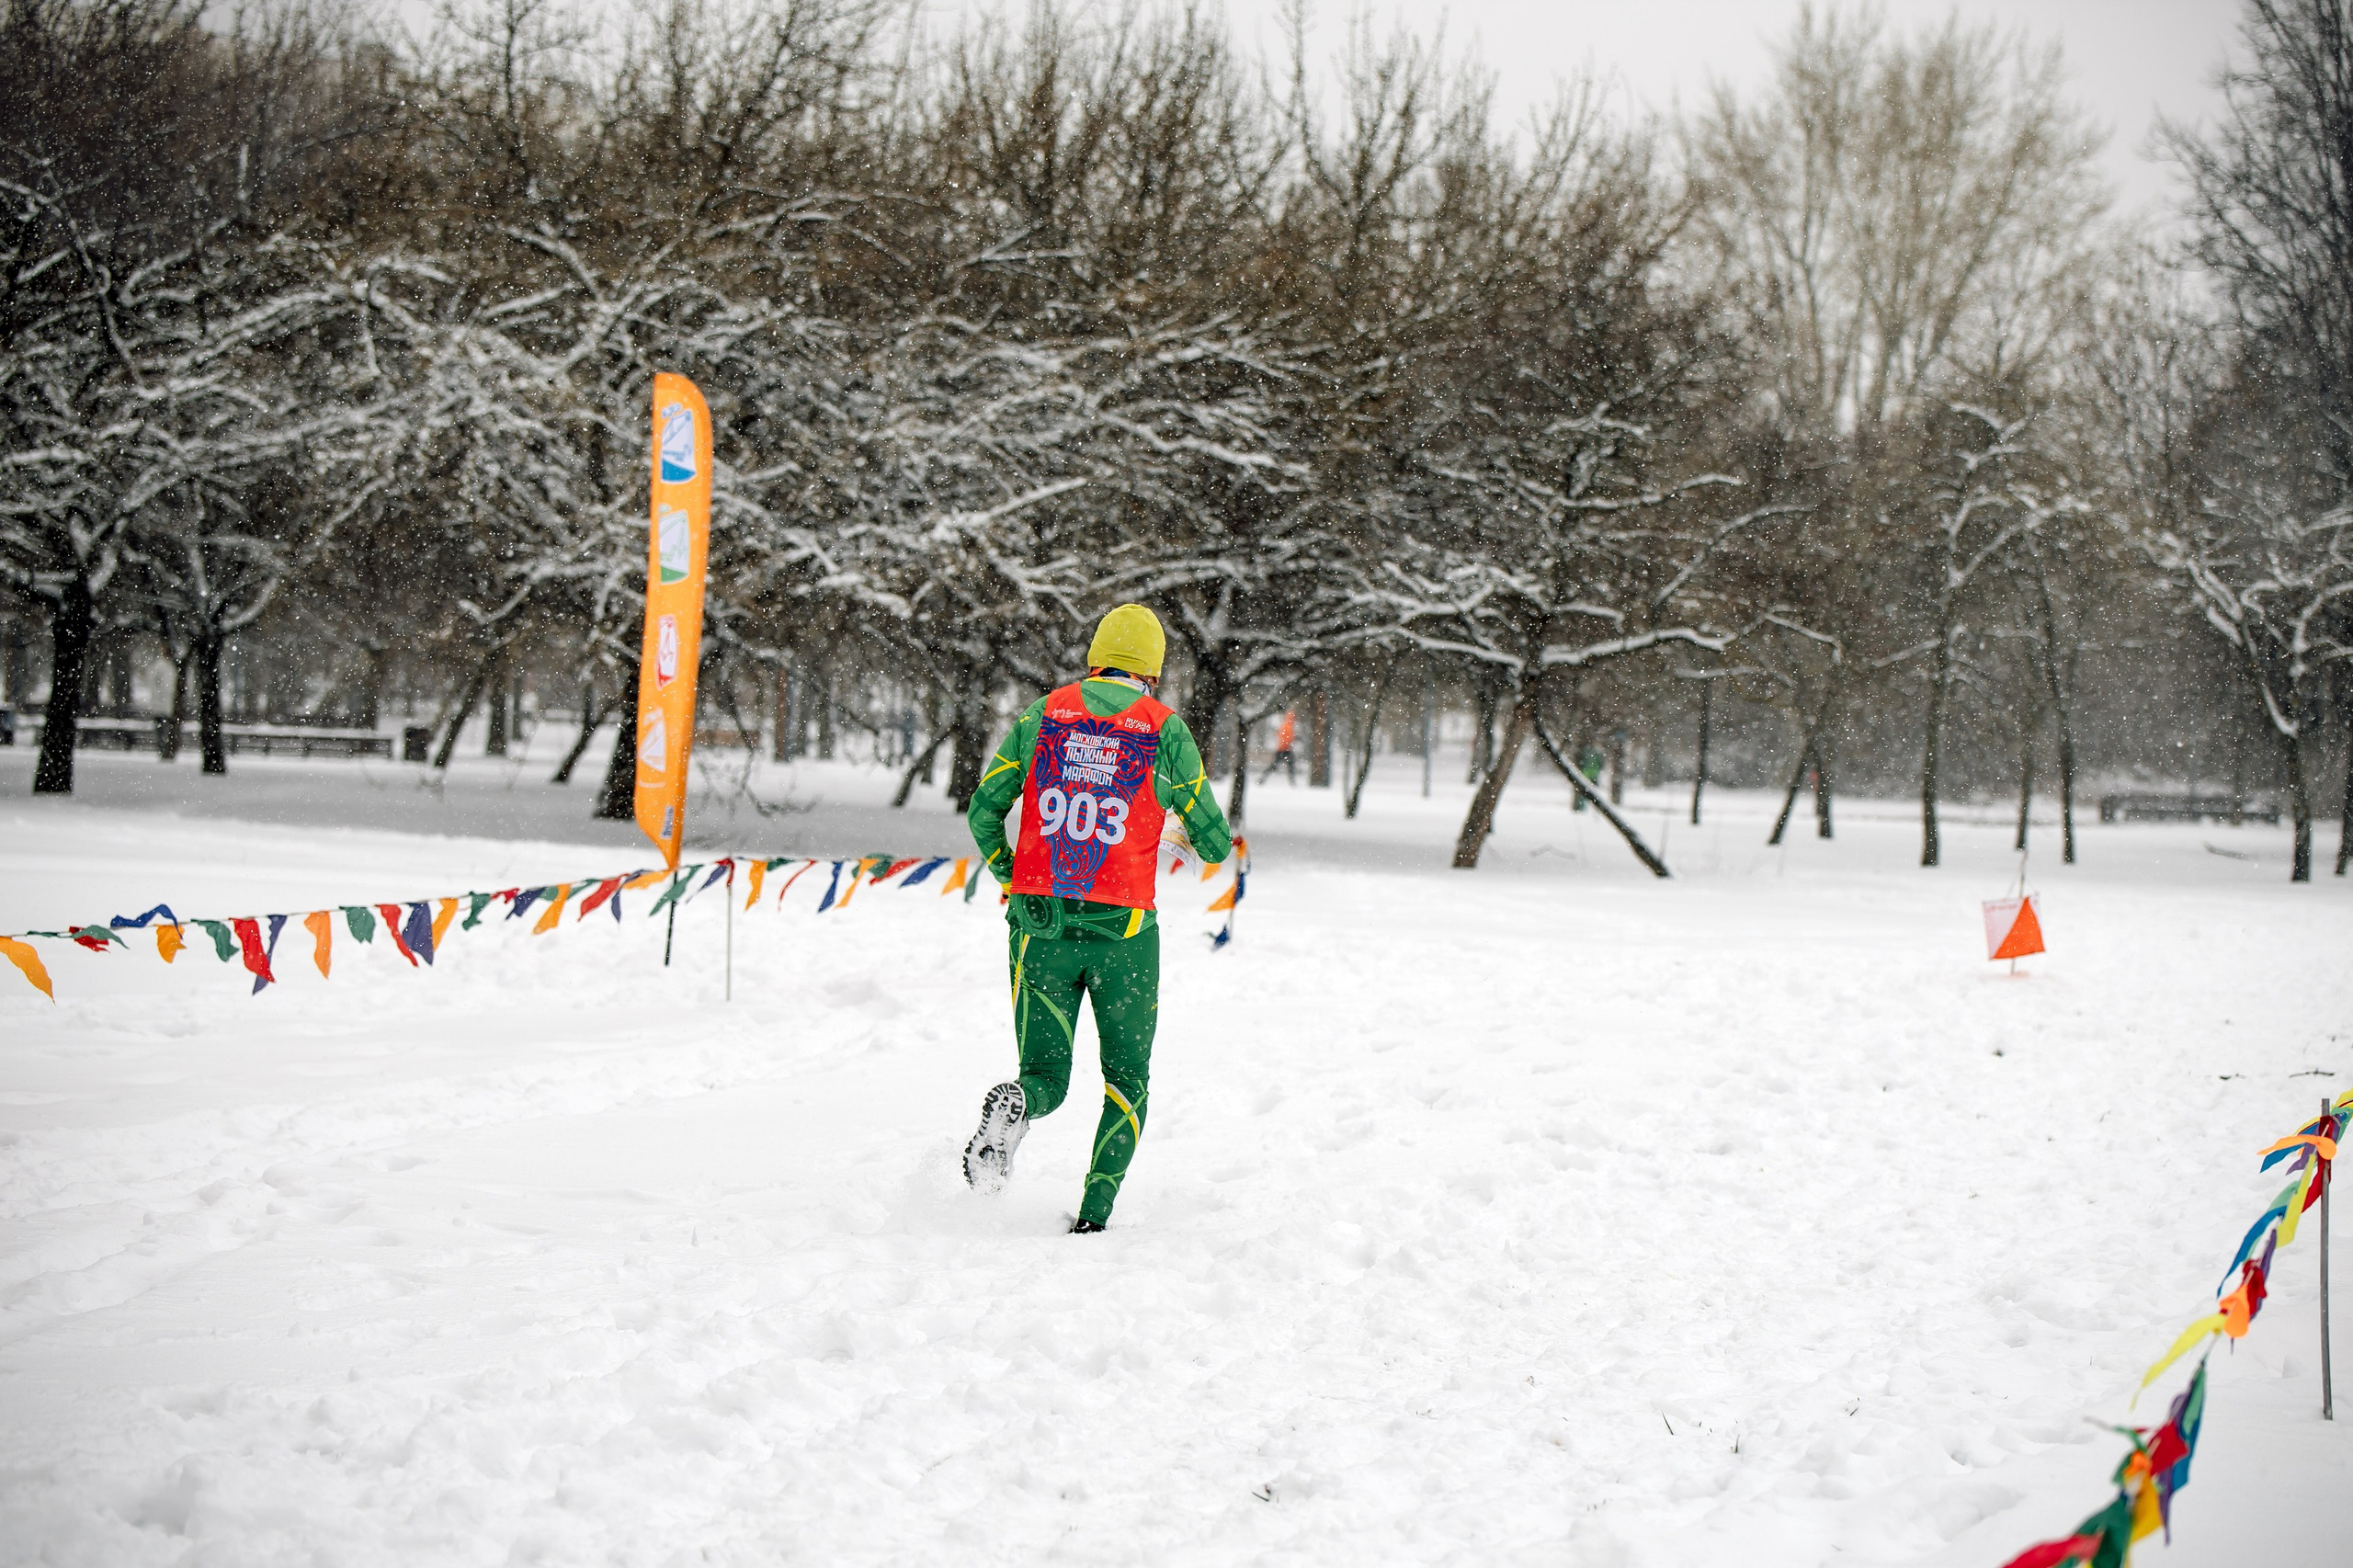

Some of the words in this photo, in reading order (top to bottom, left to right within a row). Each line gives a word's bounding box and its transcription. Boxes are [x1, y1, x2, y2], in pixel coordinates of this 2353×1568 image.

[1069, 733, 1120, 750] МОСКОВСКИЙ
[1064, 747, 1118, 765] ЛЫЖНЫЙ
[1062, 765, 1113, 787] МАРАФОН
[1039, 788, 1130, 845] 903
